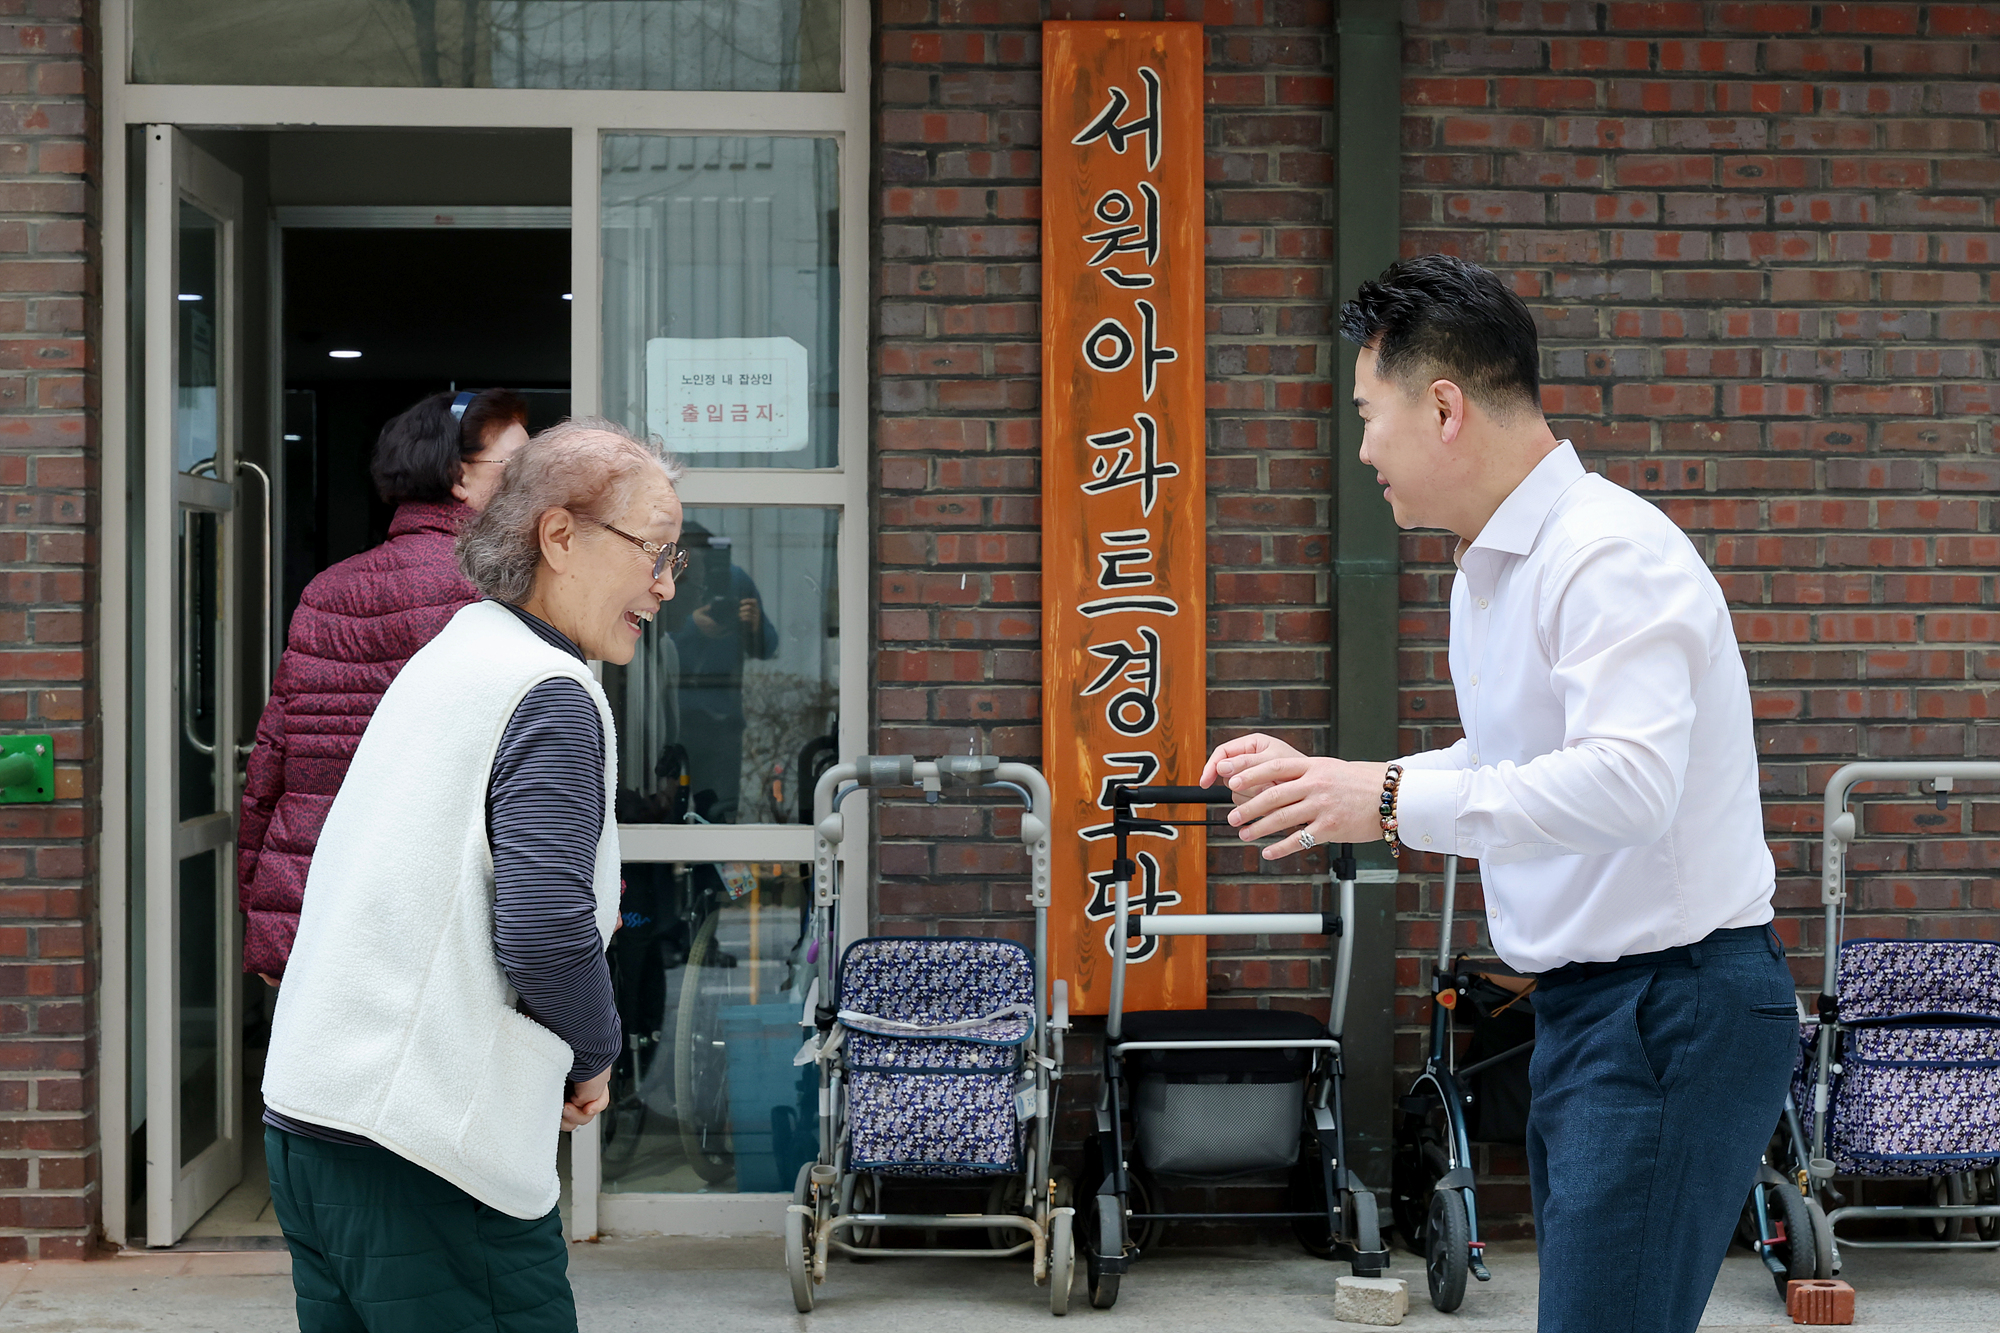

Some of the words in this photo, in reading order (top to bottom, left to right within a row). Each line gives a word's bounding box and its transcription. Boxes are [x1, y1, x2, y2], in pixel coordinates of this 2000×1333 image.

[681, 373, 716, 386] 노인정
[722, 373, 733, 386] 내
[739, 373, 773, 386] 잡상인
[681, 403, 774, 423] 출입금지
[1071, 66, 1182, 964] 서원아파트경로당
